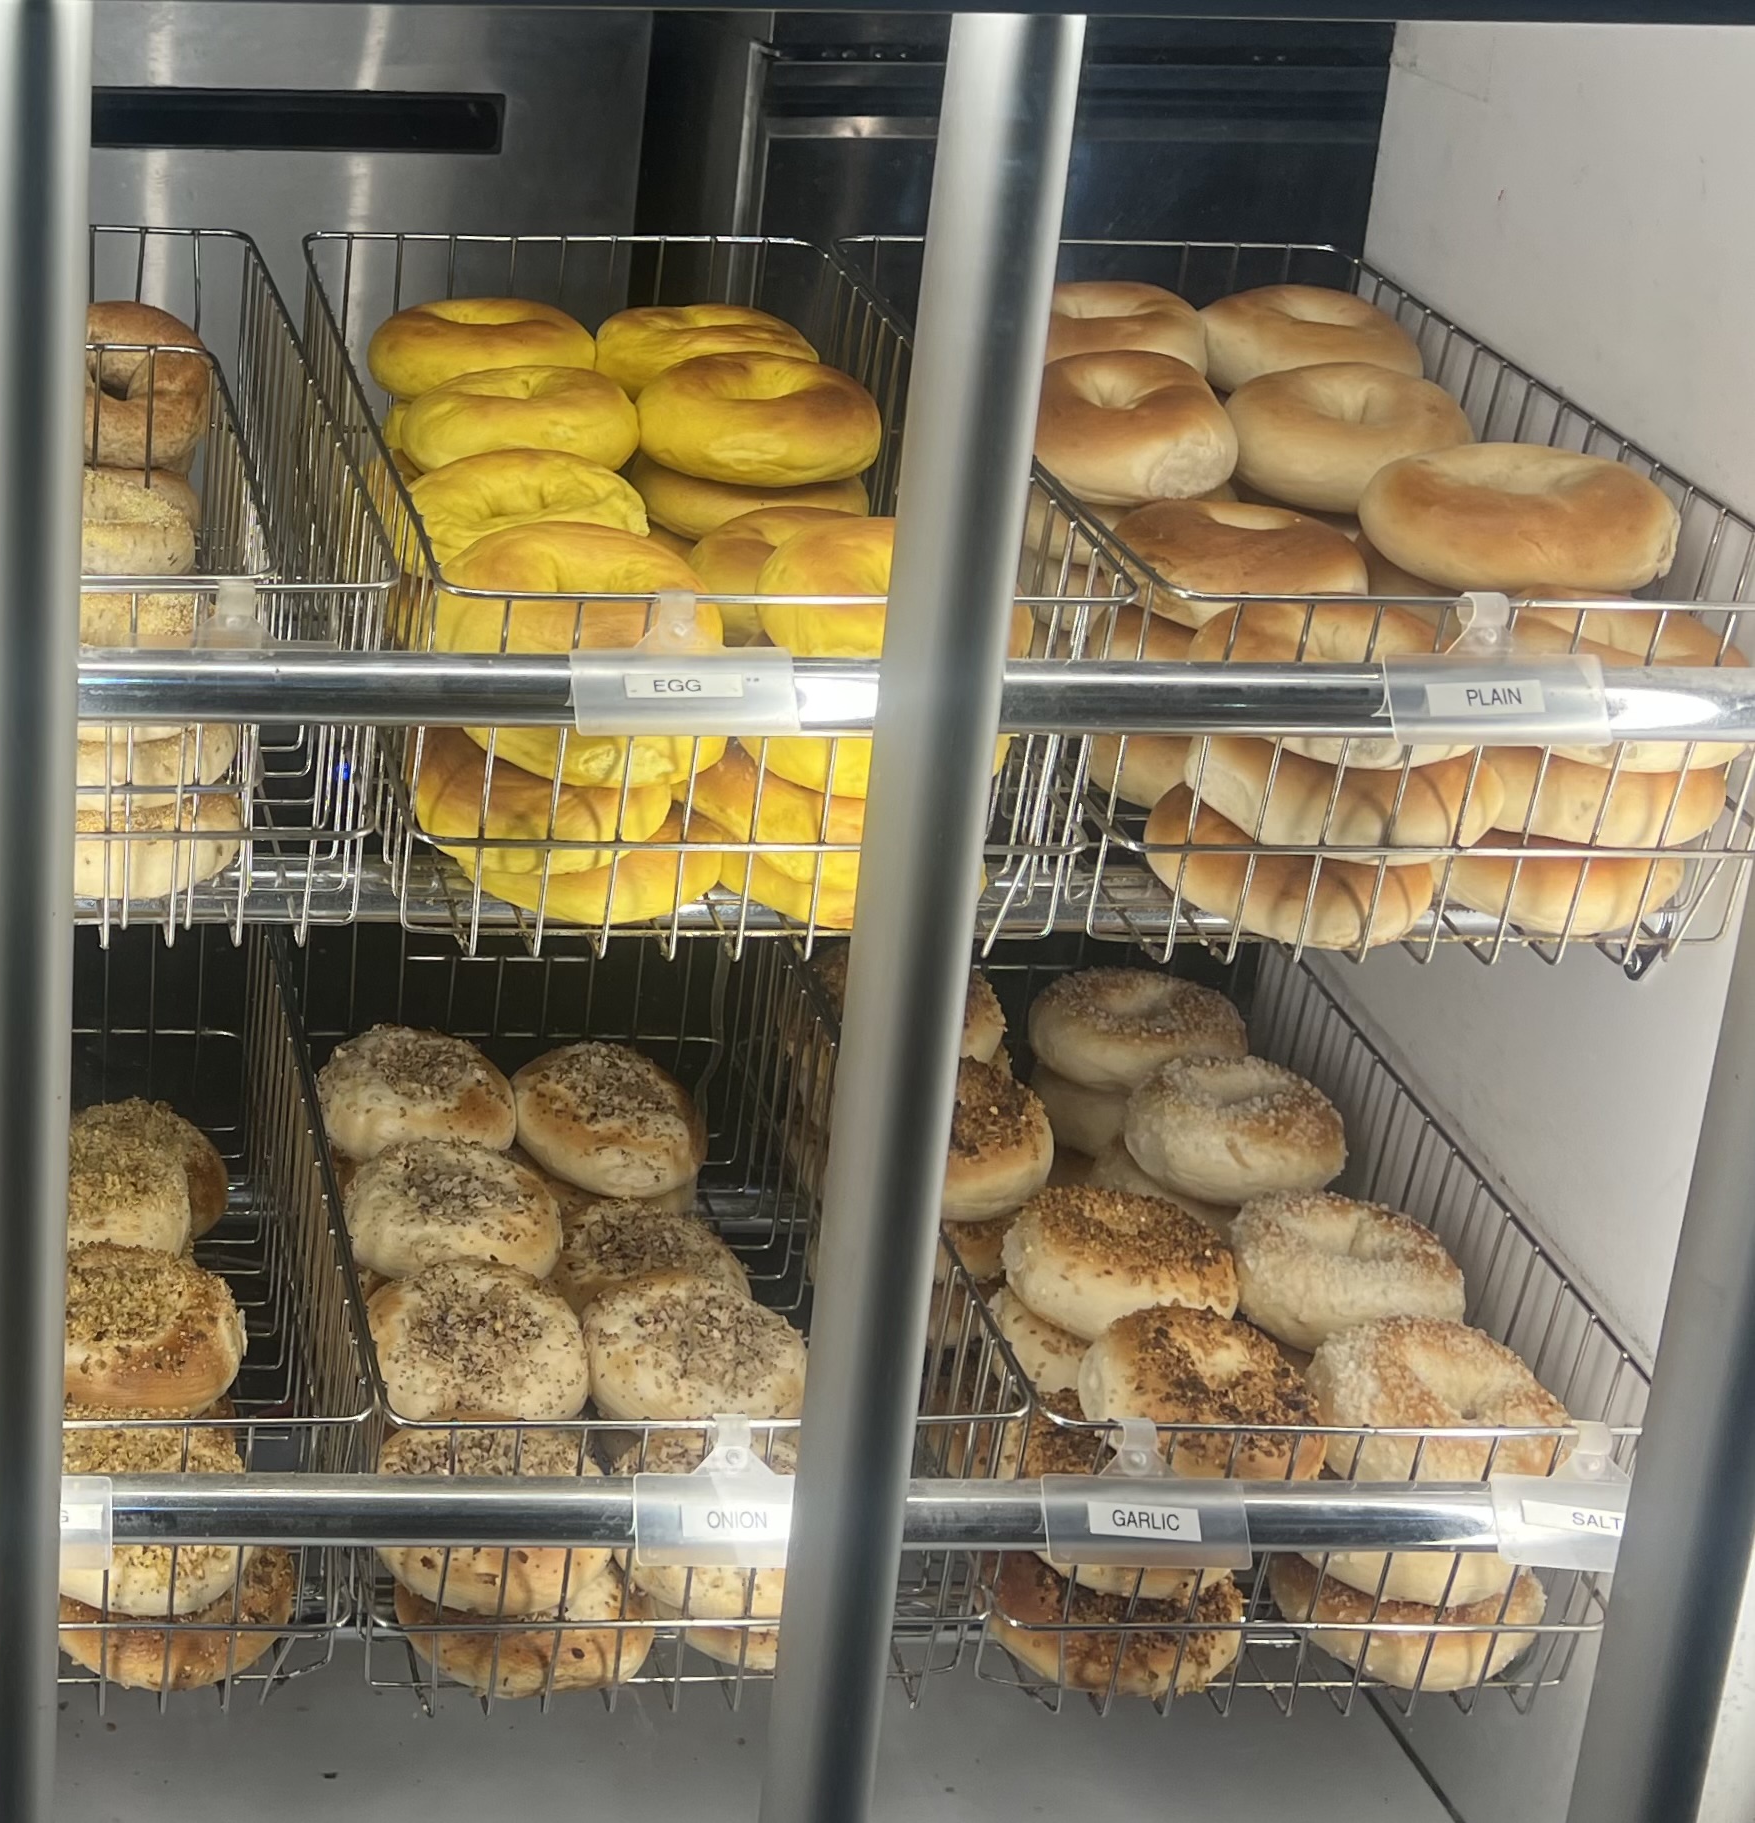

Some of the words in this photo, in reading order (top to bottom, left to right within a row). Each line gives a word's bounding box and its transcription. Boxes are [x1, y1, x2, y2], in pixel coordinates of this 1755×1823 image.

[653, 679, 701, 694] EGG
[1465, 687, 1522, 707] PLAIN
[707, 1511, 767, 1528] ONION
[1111, 1508, 1180, 1531] GARLIC
[1572, 1512, 1622, 1531] SALT
